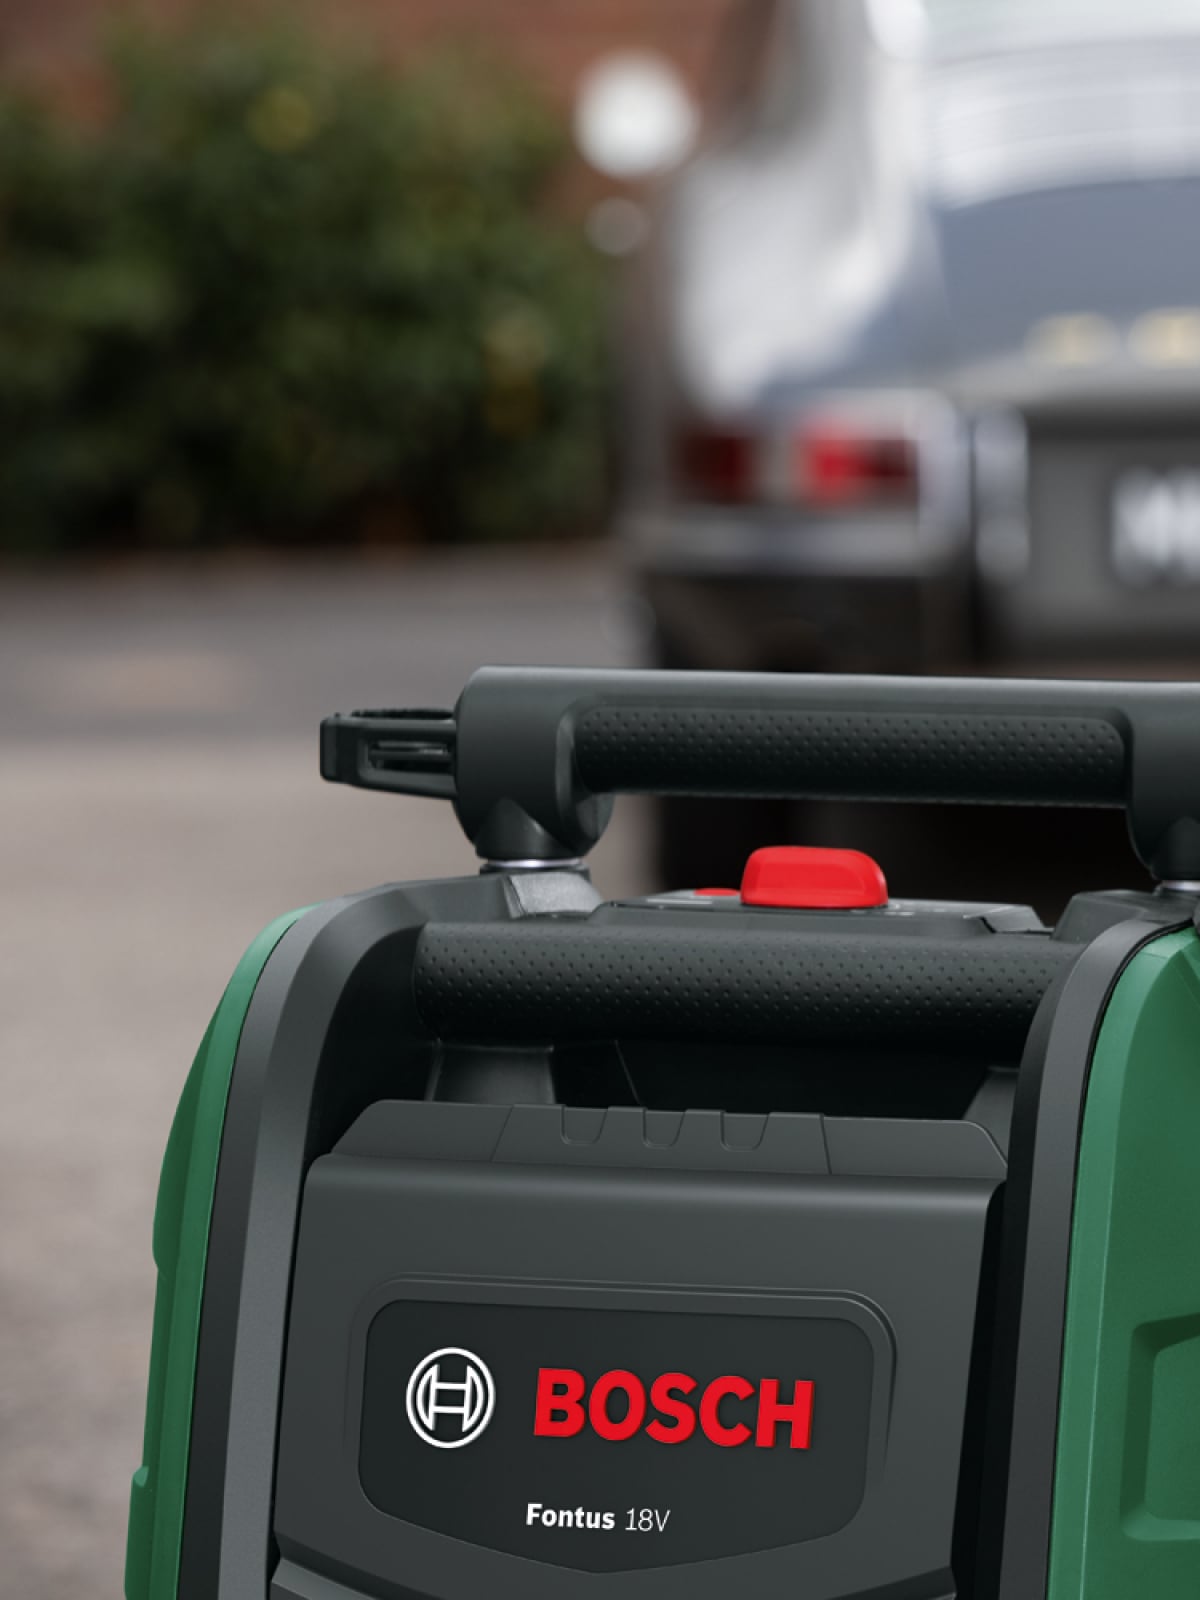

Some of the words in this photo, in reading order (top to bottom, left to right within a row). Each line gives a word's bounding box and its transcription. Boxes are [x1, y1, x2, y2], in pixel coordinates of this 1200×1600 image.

[533, 1367, 815, 1450] BOSCH
[525, 1502, 616, 1531] Fontus
[624, 1507, 671, 1533] 18V
